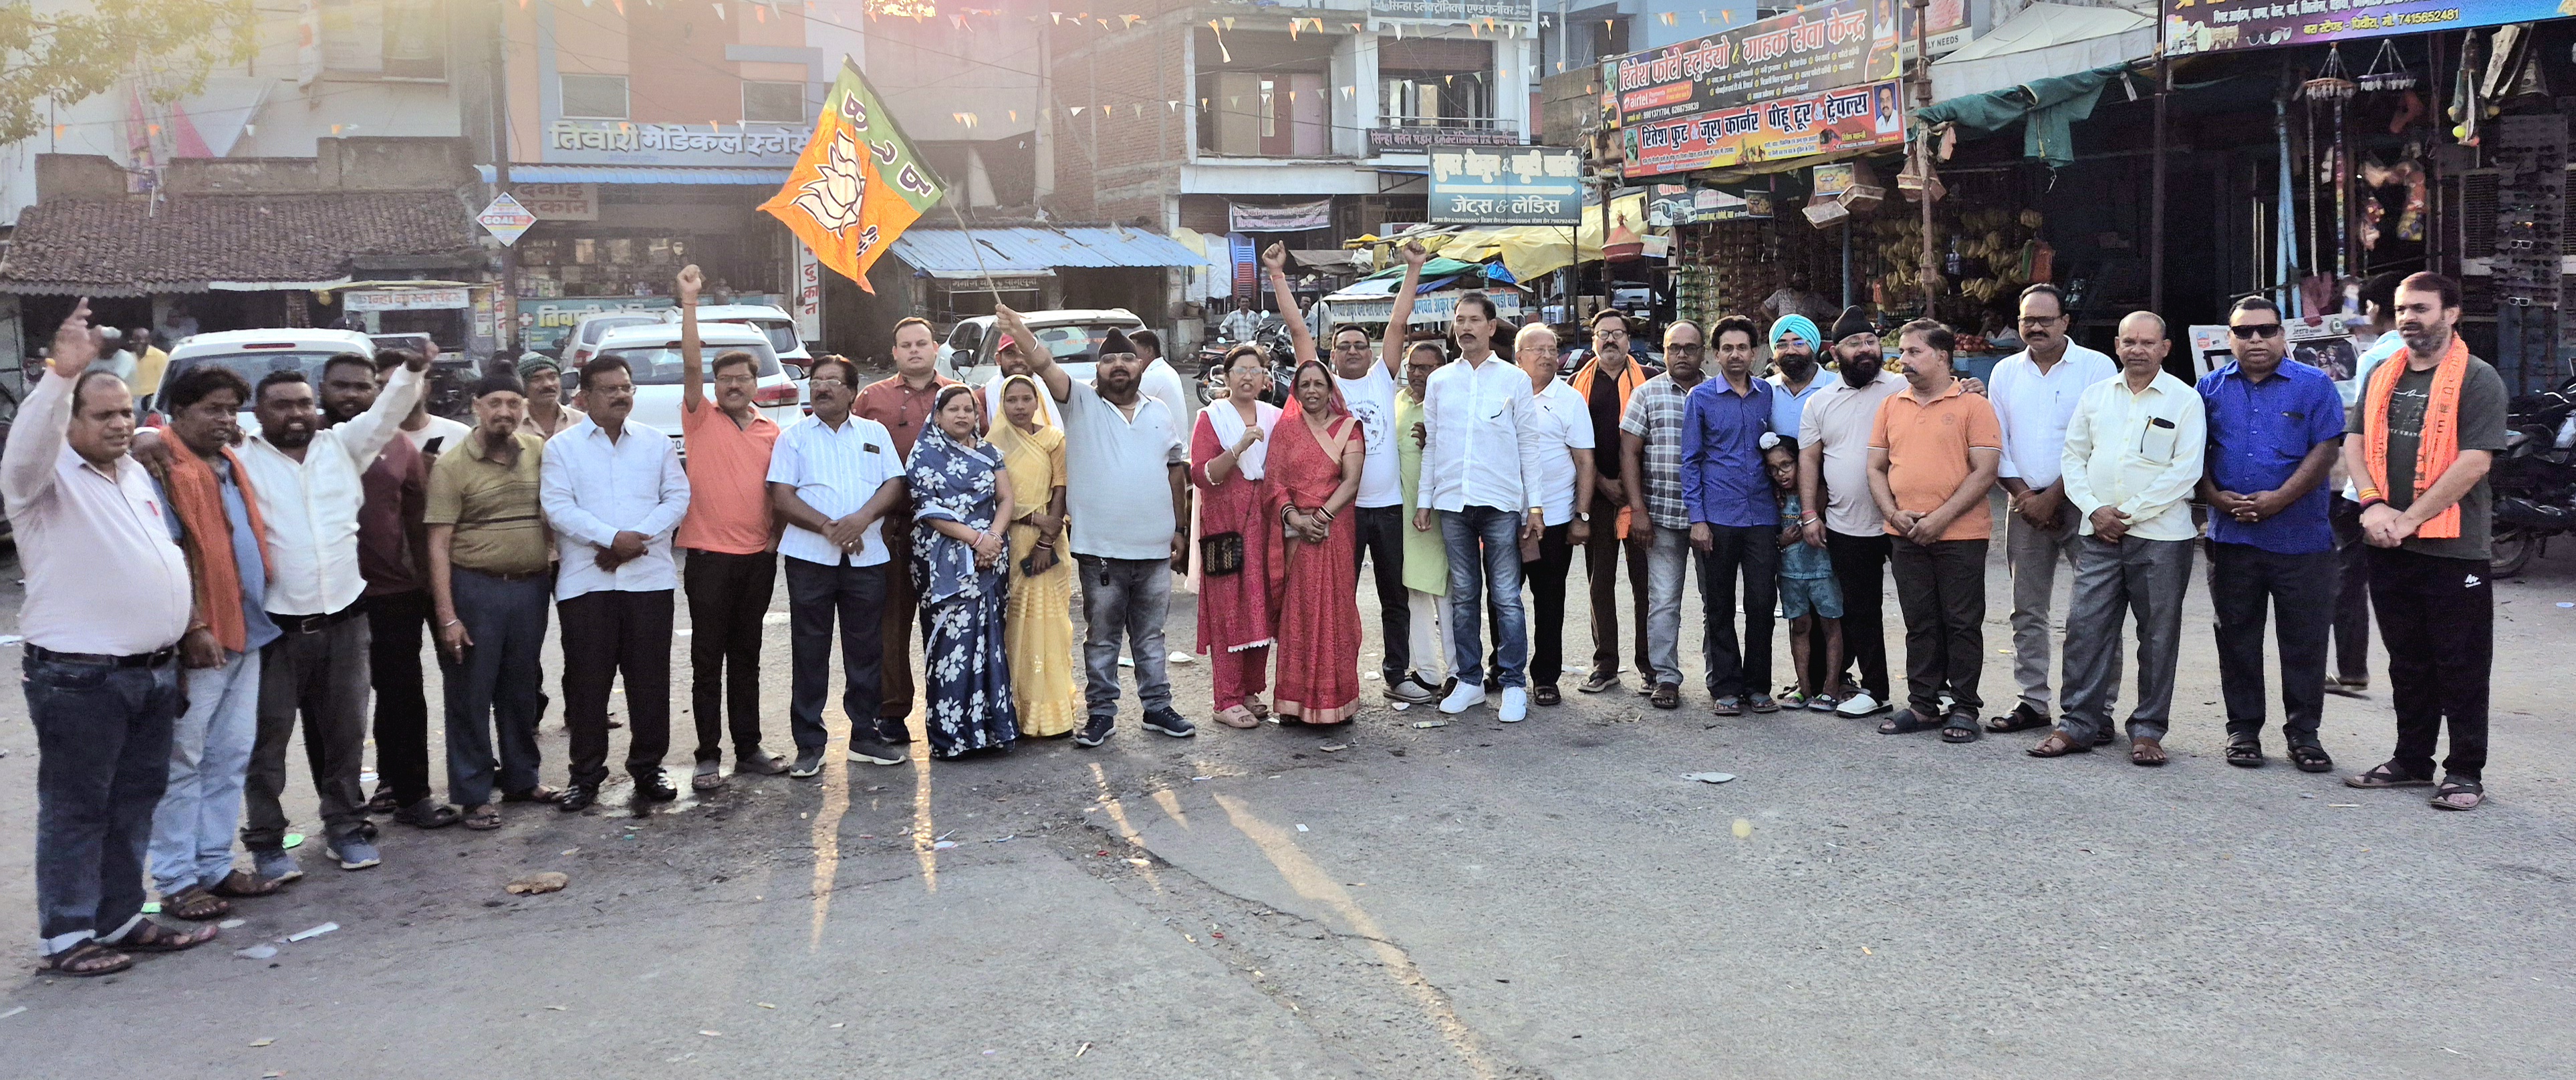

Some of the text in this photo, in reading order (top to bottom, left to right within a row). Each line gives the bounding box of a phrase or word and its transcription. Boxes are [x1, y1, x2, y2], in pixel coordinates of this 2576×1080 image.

[2398, 8, 2460, 25] 7415652481
[1619, 57, 1651, 92] रितेश
[1651, 47, 1682, 84] फोटो
[1683, 35, 1730, 83] स्टूडियो
[1742, 28, 1789, 65] ग्राहक
[1791, 15, 1825, 53] सेवा
[1827, 7, 1867, 45] केन्द्र
[1903, 45, 1915, 54] IXIT
[1937, 35, 1959, 47] NEEDS
[1630, 93, 1649, 108] airtel
[1641, 125, 1668, 148] रितेश
[1698, 118, 1722, 146] जूस
[1793, 102, 1813, 131] टूर
[1825, 91, 1870, 125] ट्रेवल्स
[549, 120, 640, 153] तिवारी
[641, 125, 747, 154] मेडिकल
[1370, 130, 1392, 146] सिन्हा
[1511, 194, 1561, 215] लेडिस
[482, 215, 515, 226] GOAL
